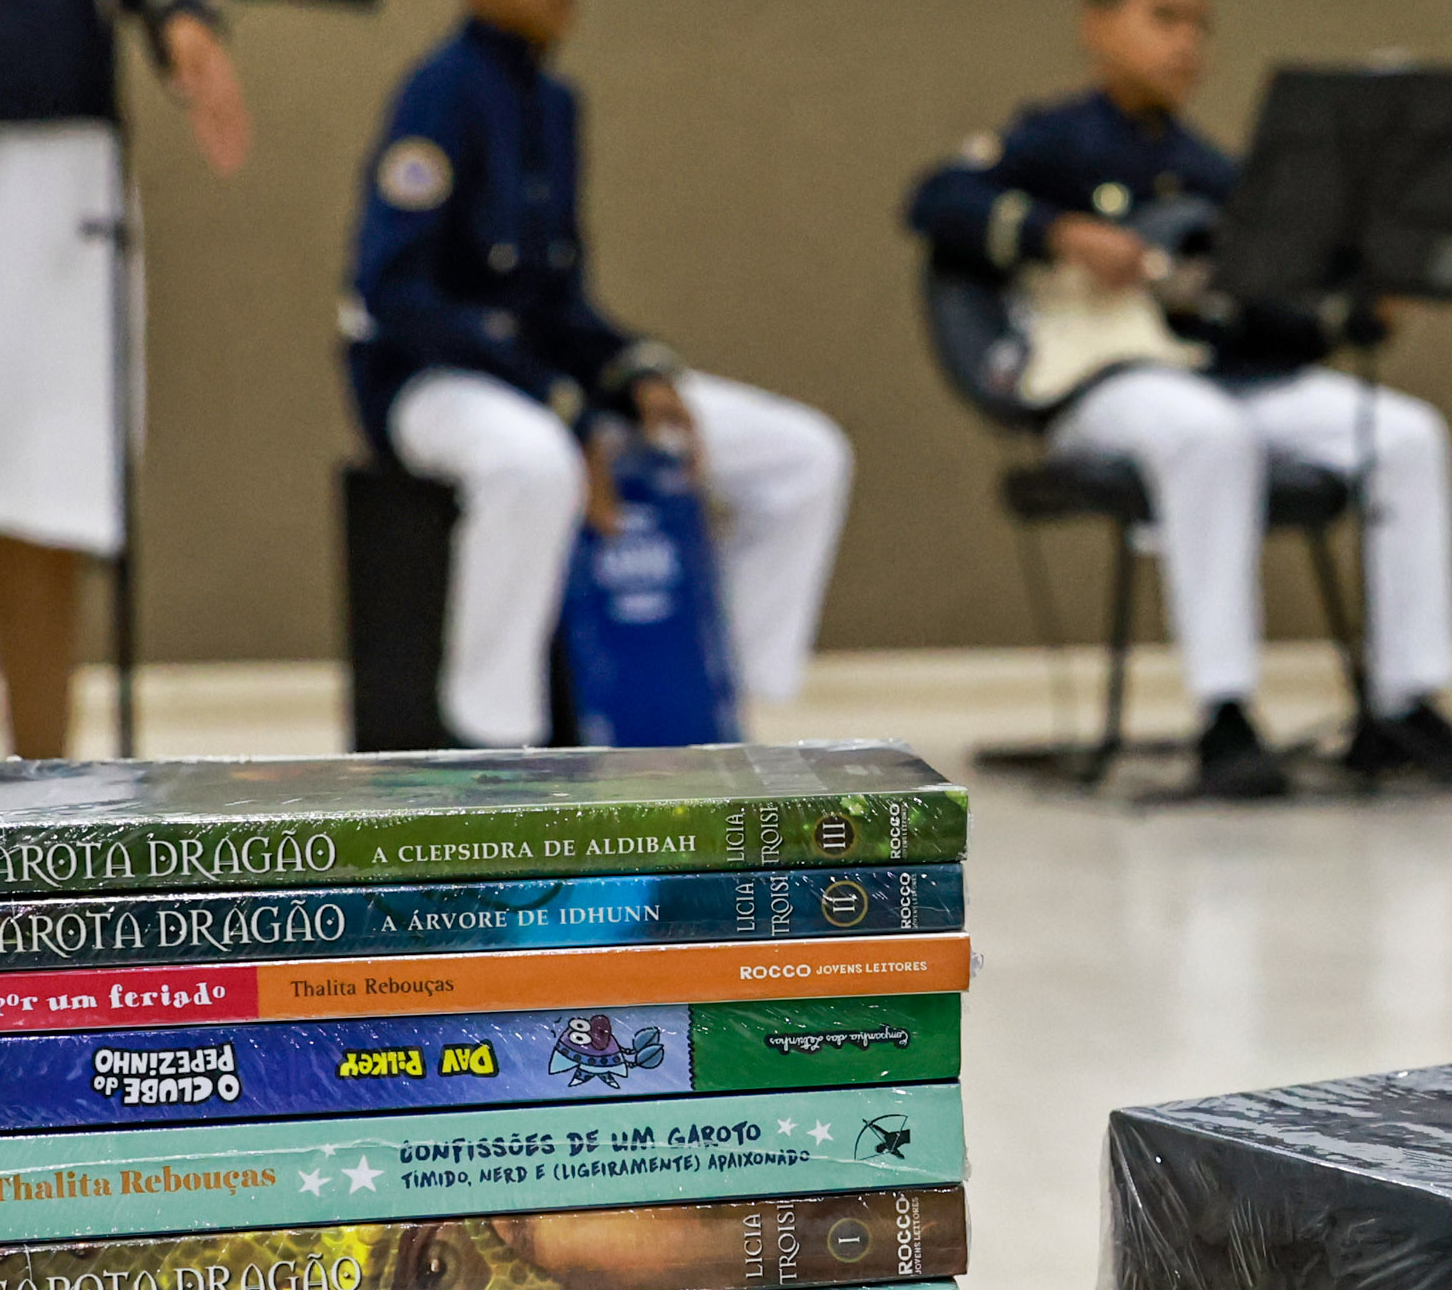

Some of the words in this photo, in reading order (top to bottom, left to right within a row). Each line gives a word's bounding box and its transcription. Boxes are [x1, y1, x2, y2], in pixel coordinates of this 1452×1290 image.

[148, 832, 337, 880] DRAGÃO
[371, 848, 387, 864] A
[398, 842, 533, 863] CLEPSIDRA
[544, 839, 576, 857] DE
[588, 835, 696, 854] ALDIBAH
[158, 902, 346, 951] DRAGÃO
[381, 916, 396, 931] A
[407, 909, 507, 931] ÁRVORE
[518, 908, 549, 925] DE
[559, 904, 661, 924] IDHUNN
[48, 993, 97, 1011] um
[110, 983, 226, 1009] feriado
[291, 977, 356, 998] Thalita
[365, 975, 454, 999] Rebouças
[740, 964, 811, 979] ROCCO
[816, 963, 863, 975] JOVENS
[866, 961, 927, 973] LEITORES
[95, 1045, 234, 1073] PEPEZINHO
[440, 1044, 496, 1074] DAV
[124, 1075, 213, 1104] CLUBE
[218, 1074, 240, 1101] O
[120, 1163, 276, 1196] Rebouças
[400, 1133, 553, 1162] CONFISSÕES
[567, 1130, 601, 1154] DE
[611, 1126, 654, 1151] UM
[668, 1120, 761, 1148] GAROTO
[479, 1165, 528, 1183] NERD
[535, 1163, 546, 1179] E
[553, 1154, 700, 1182] (LIGEIRAMENTE)
[708, 1148, 809, 1170] APAIXONADO
[746, 1214, 763, 1279] LICIA
[779, 1204, 797, 1285] TROISI
[898, 1200, 912, 1275] ROCCO
